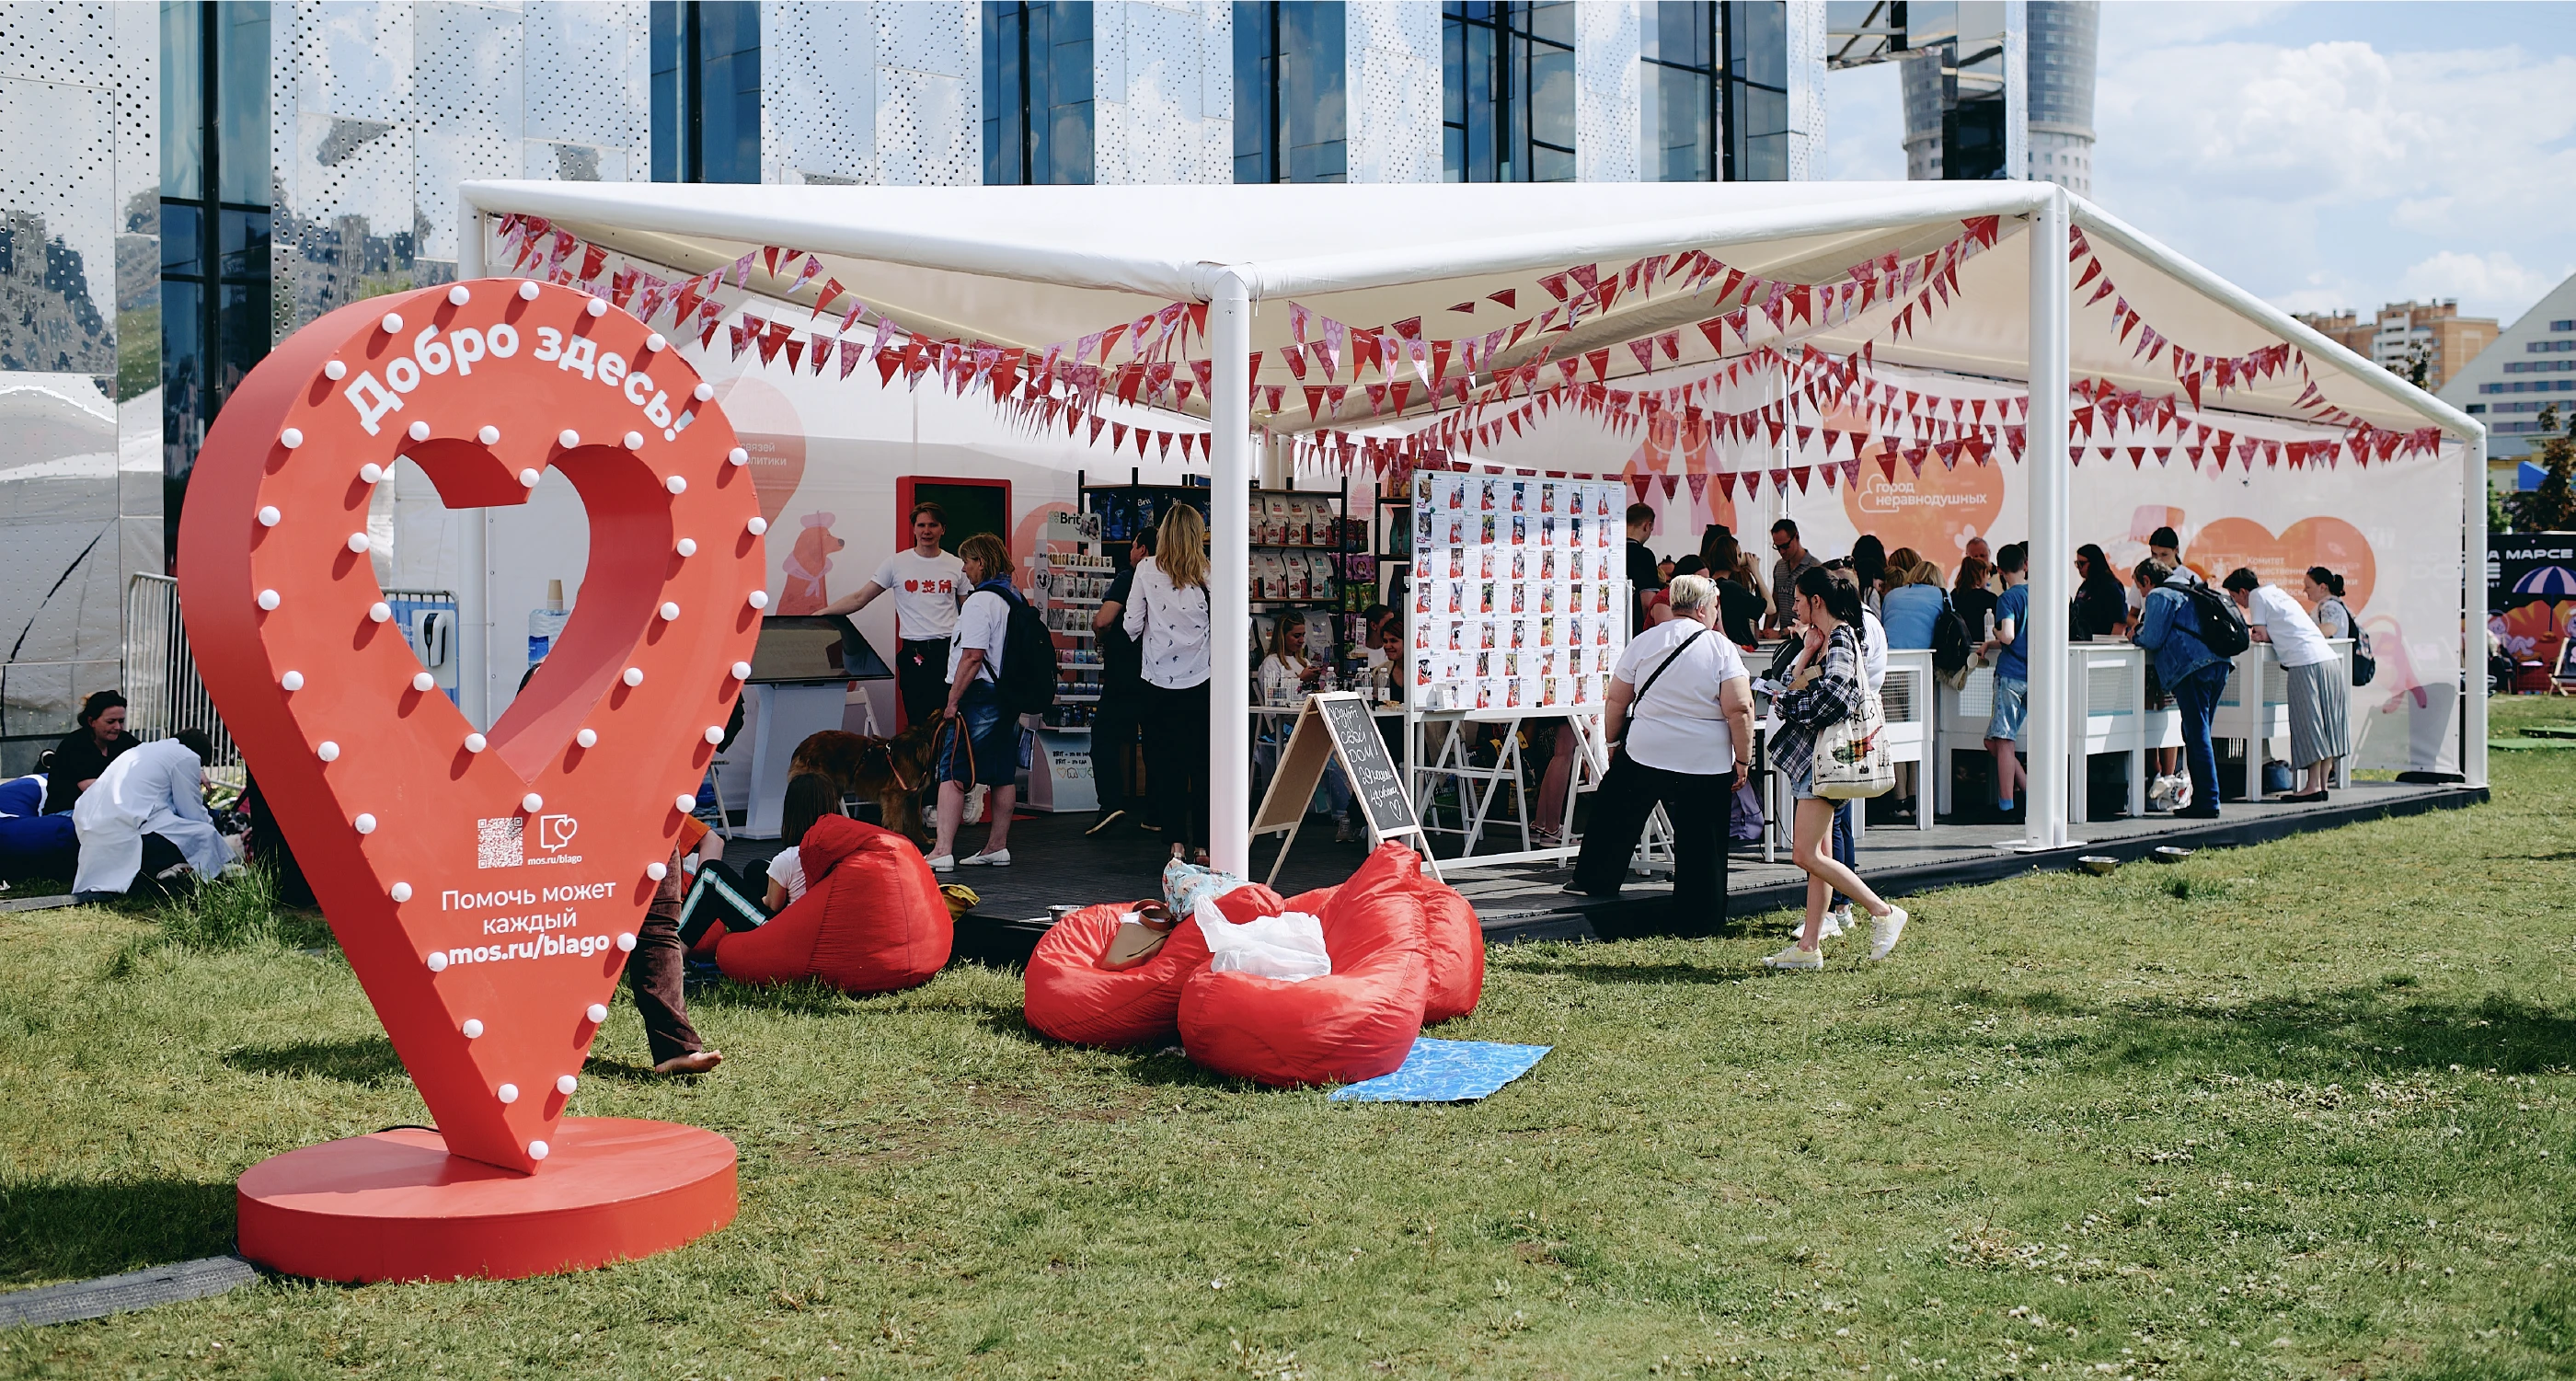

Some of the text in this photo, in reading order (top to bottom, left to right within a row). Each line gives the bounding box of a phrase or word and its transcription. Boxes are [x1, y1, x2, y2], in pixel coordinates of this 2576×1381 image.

[344, 323, 696, 443] Добро здесь!
[747, 457, 787, 466] олитики
[1877, 483, 1915, 495] город
[1877, 494, 1987, 508] неравнодушных
[1060, 512, 1081, 525] Brit
[2505, 549, 2573, 559] МАРСЕ
[2247, 557, 2284, 565] Комитет
[527, 854, 582, 866] mos.ru/blago
[442, 881, 616, 912] Помочь может
[483, 907, 577, 936] каждый
[449, 934, 609, 965] mos.ru/blago
